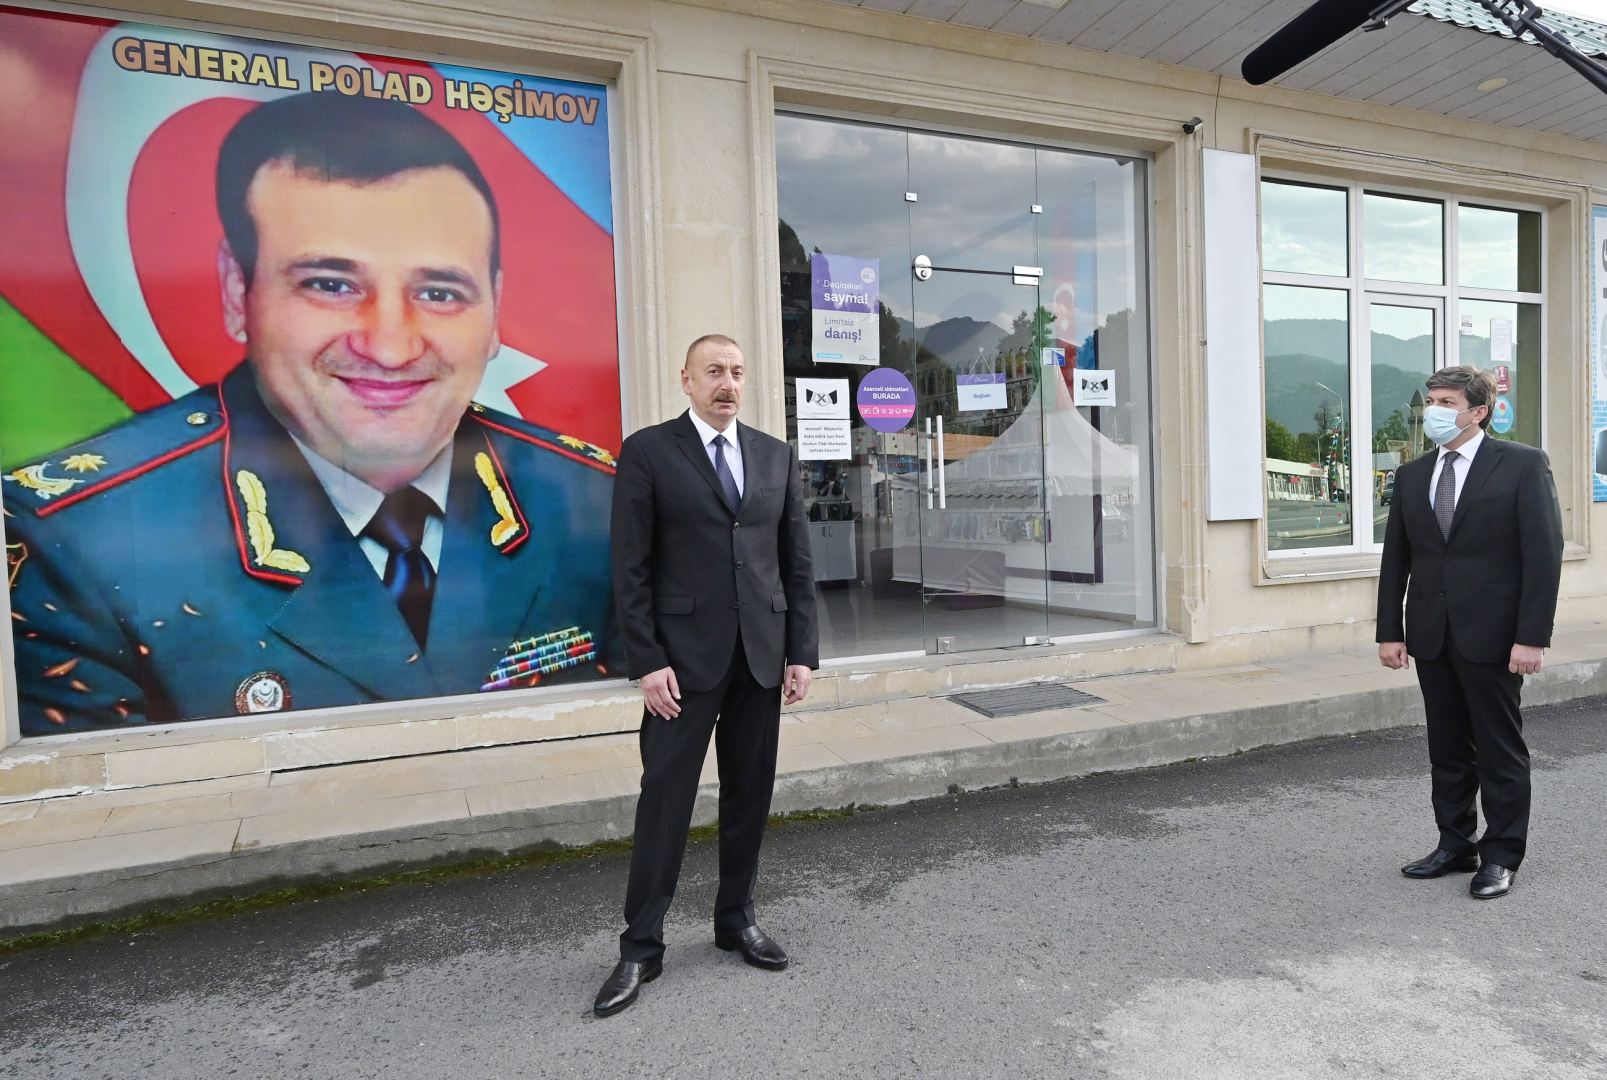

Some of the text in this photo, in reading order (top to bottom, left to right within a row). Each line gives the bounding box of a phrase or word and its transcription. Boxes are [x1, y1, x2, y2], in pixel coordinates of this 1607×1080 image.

[112, 36, 599, 125] GENERAL POLAD HƏŞİMOV
[824, 292, 868, 305] sayma!
[824, 317, 854, 327] Limitsiz
[824, 327, 862, 343] danış!
[872, 392, 901, 400] BURADA
